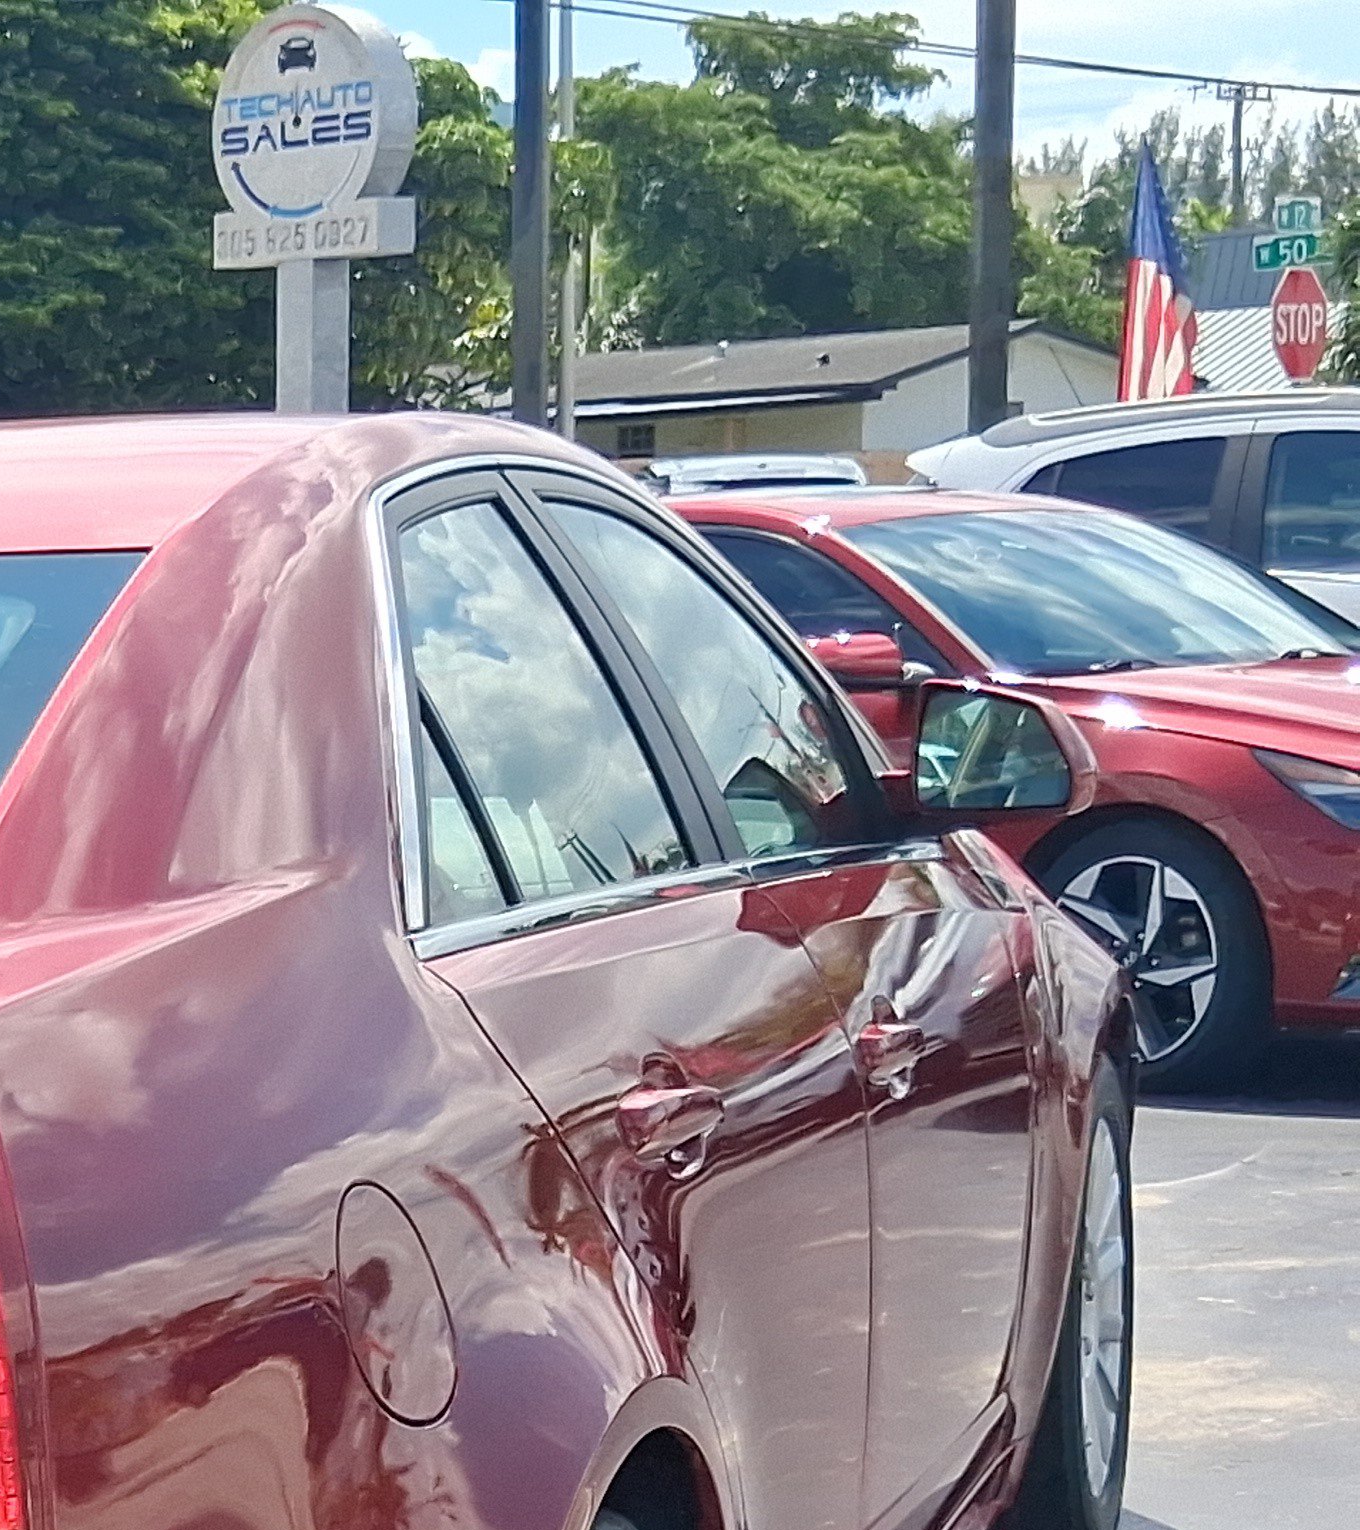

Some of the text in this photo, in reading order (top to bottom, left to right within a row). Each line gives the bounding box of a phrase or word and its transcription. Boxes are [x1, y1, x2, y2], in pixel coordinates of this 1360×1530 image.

[221, 110, 373, 157] SALES
[1279, 238, 1307, 266] 50
[1275, 302, 1324, 345] STOP
